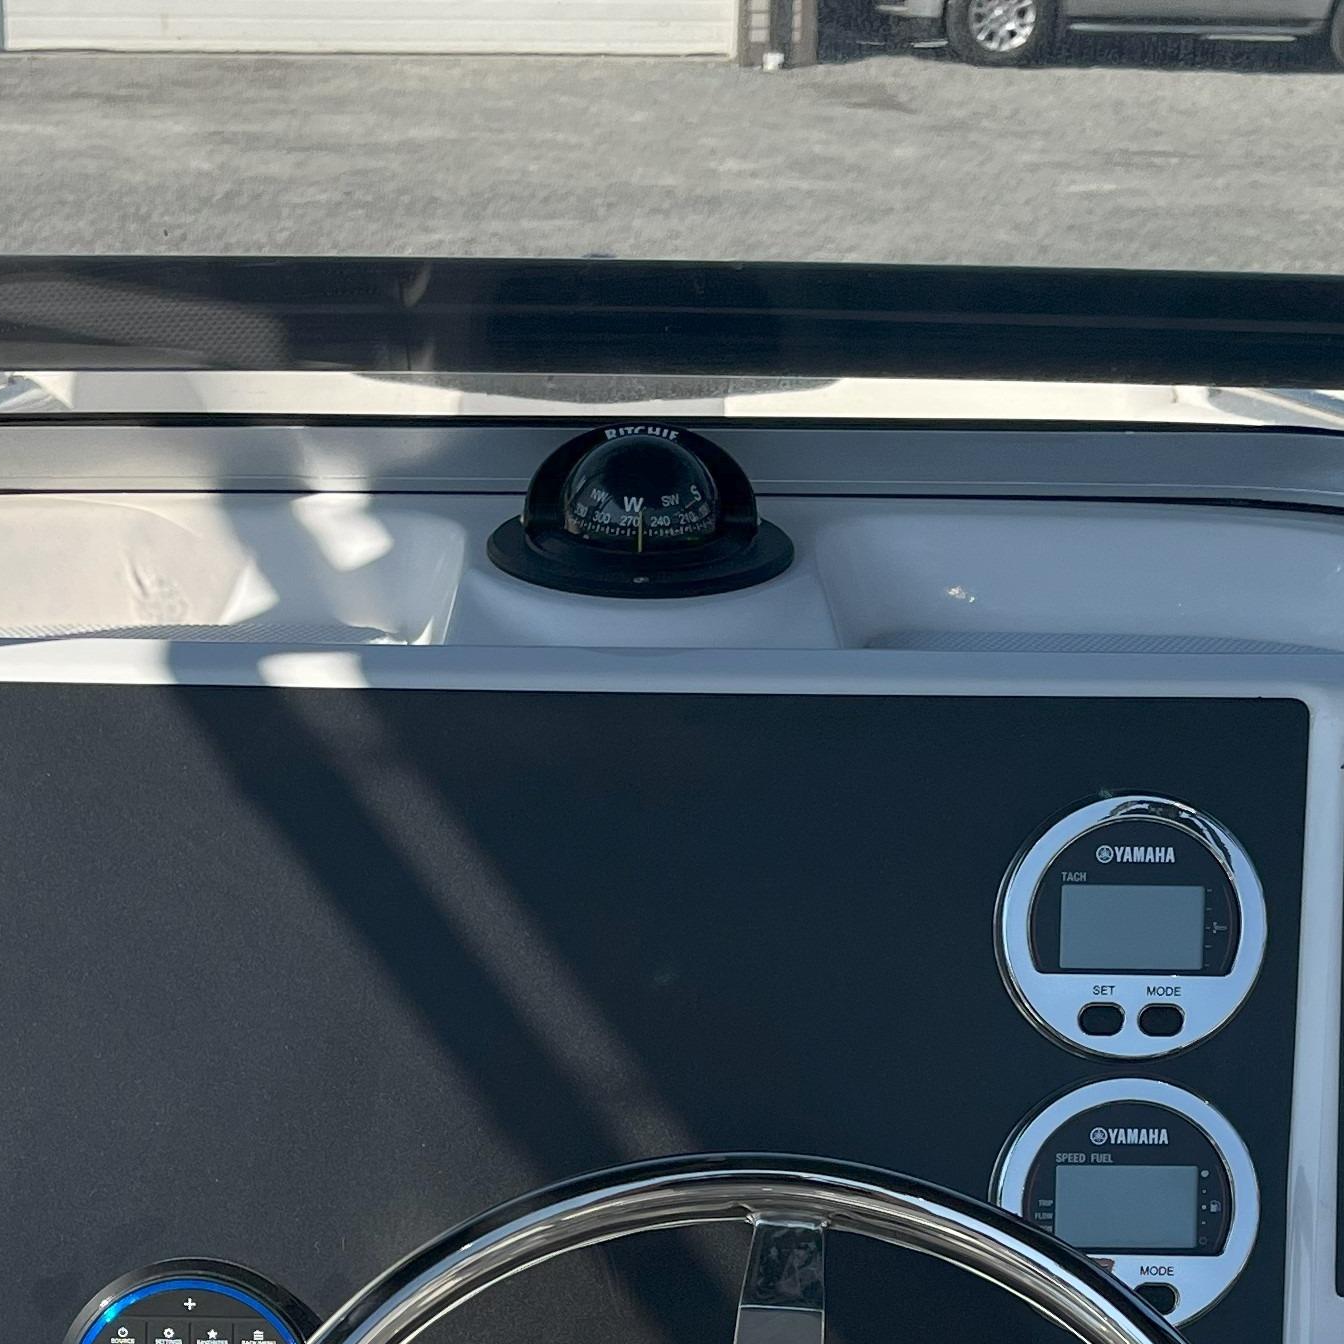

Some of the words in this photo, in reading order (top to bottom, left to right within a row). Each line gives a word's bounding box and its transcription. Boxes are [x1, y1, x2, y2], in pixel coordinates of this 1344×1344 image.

[623, 496, 644, 512] W
[661, 494, 679, 506] SW
[690, 485, 702, 502] S
[620, 515, 640, 527] 270
[650, 516, 670, 527] 240
[1114, 847, 1176, 863] YAMAHA
[1061, 872, 1087, 882] TACH
[1092, 985, 1116, 996] SET
[1146, 986, 1182, 997] MODE
[1108, 1128, 1169, 1145] YAMAHA
[1056, 1153, 1086, 1163] SPEED
[1090, 1153, 1113, 1163] FUEL
[1140, 1266, 1174, 1276] MODE
